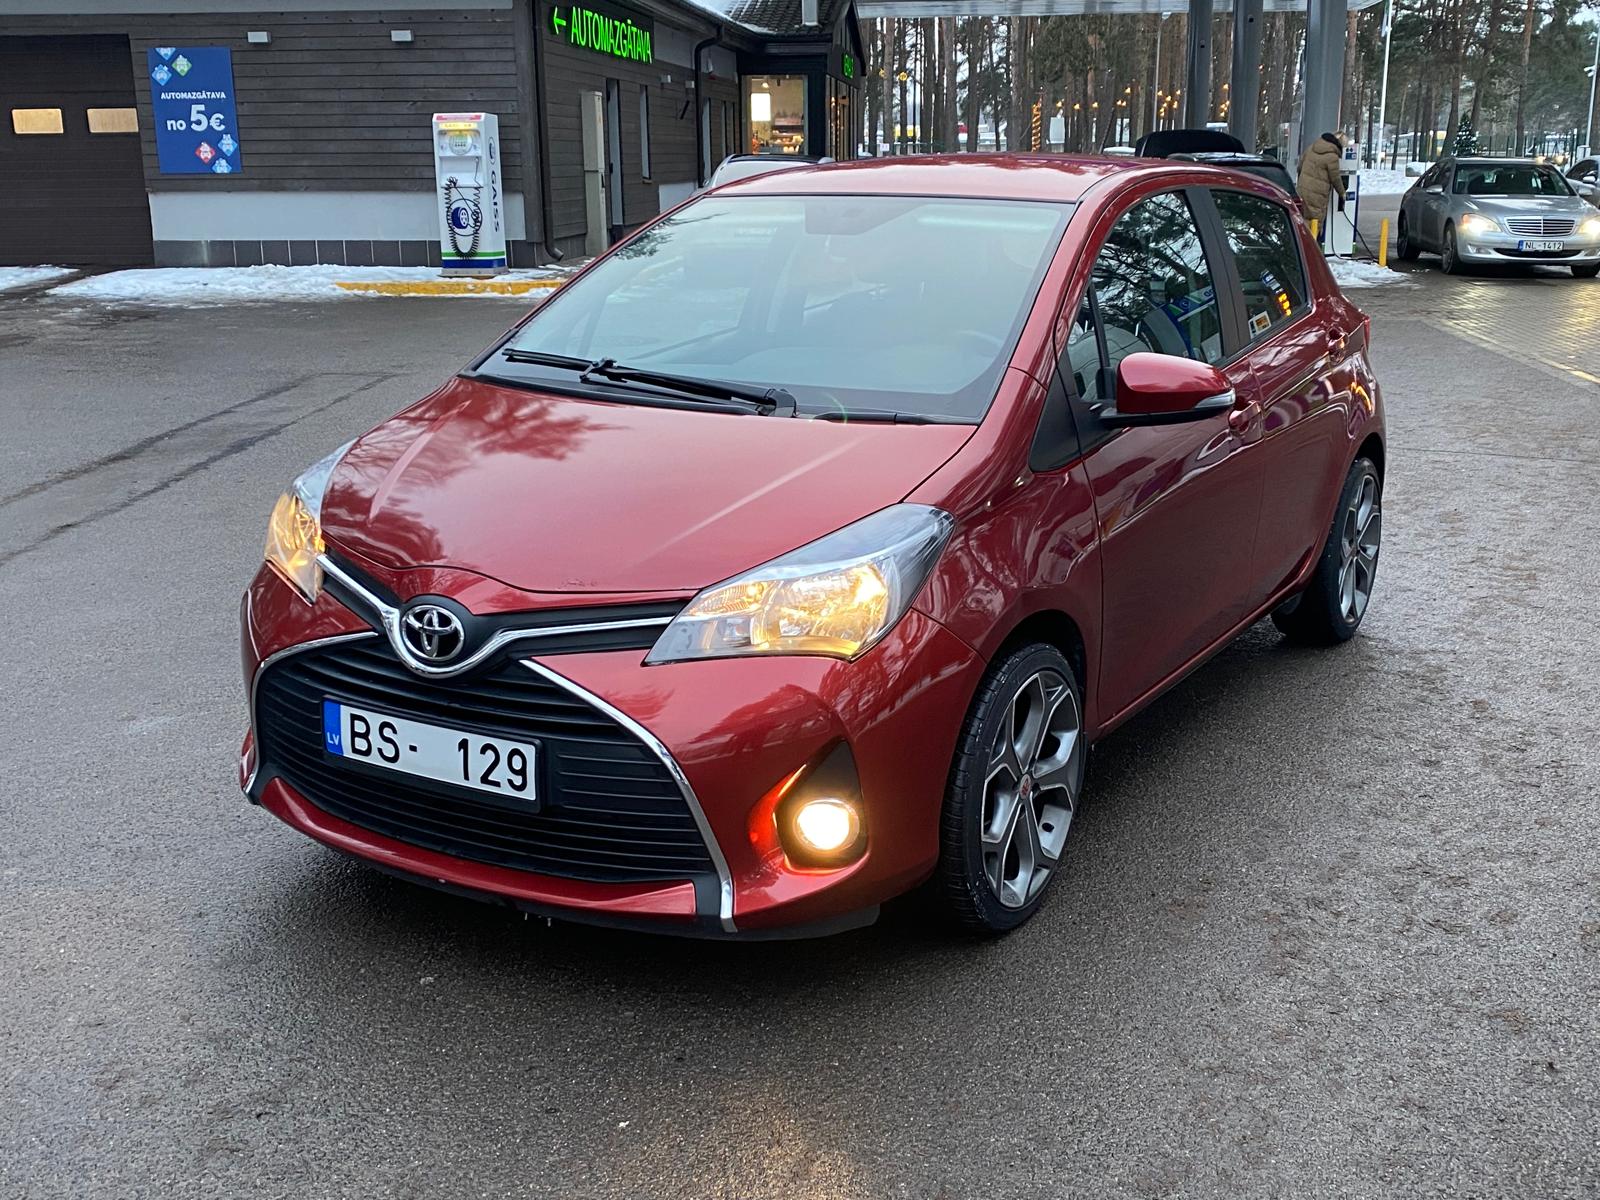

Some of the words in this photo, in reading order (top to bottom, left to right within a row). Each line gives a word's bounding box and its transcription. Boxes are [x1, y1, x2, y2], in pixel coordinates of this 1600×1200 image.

[571, 5, 653, 64] AUTOMAZGĀTAVA
[160, 90, 226, 100] AUTOMAZGĀTAVA
[166, 119, 187, 131] no
[490, 170, 499, 232] GAISS
[326, 731, 340, 746] LV
[457, 737, 528, 792] 129
